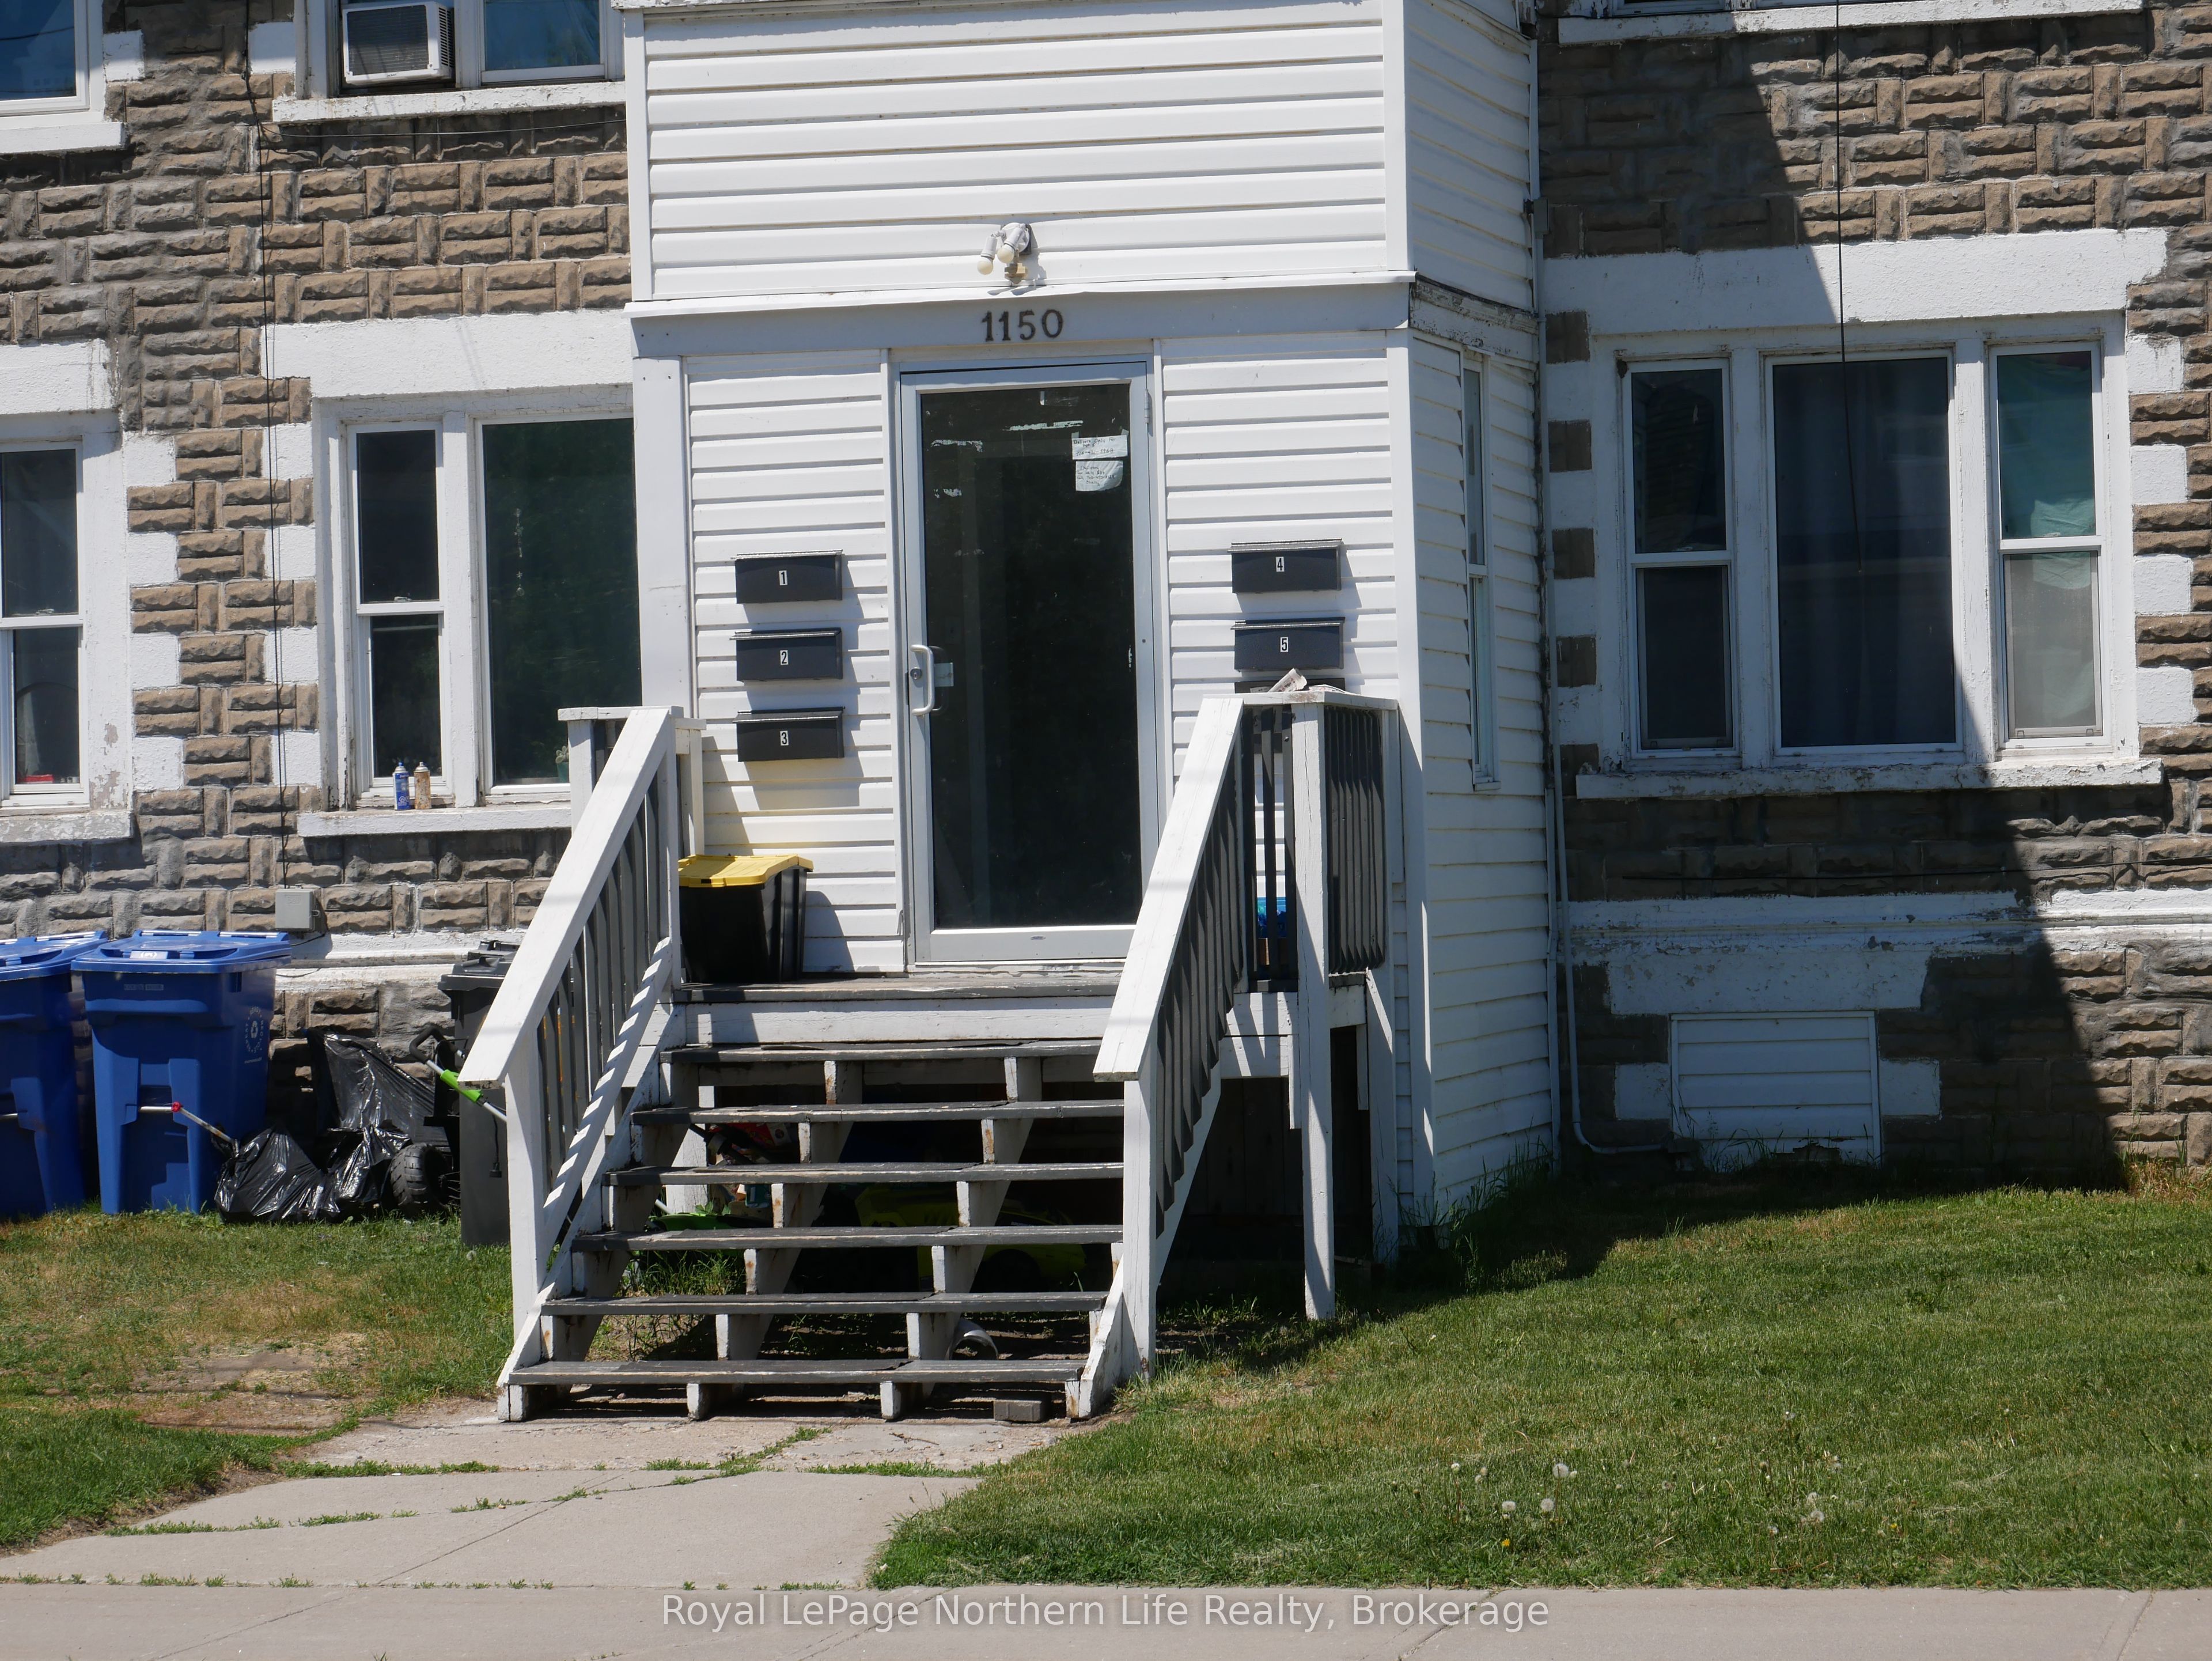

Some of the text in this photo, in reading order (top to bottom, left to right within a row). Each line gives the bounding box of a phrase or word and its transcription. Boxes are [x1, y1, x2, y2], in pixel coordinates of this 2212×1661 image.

[982, 309, 1063, 341] 1150
[1277, 558, 1283, 570] 4
[781, 572, 786, 584] 1
[1281, 638, 1287, 651] 5
[781, 651, 787, 665] 2
[782, 732, 787, 745] 3
